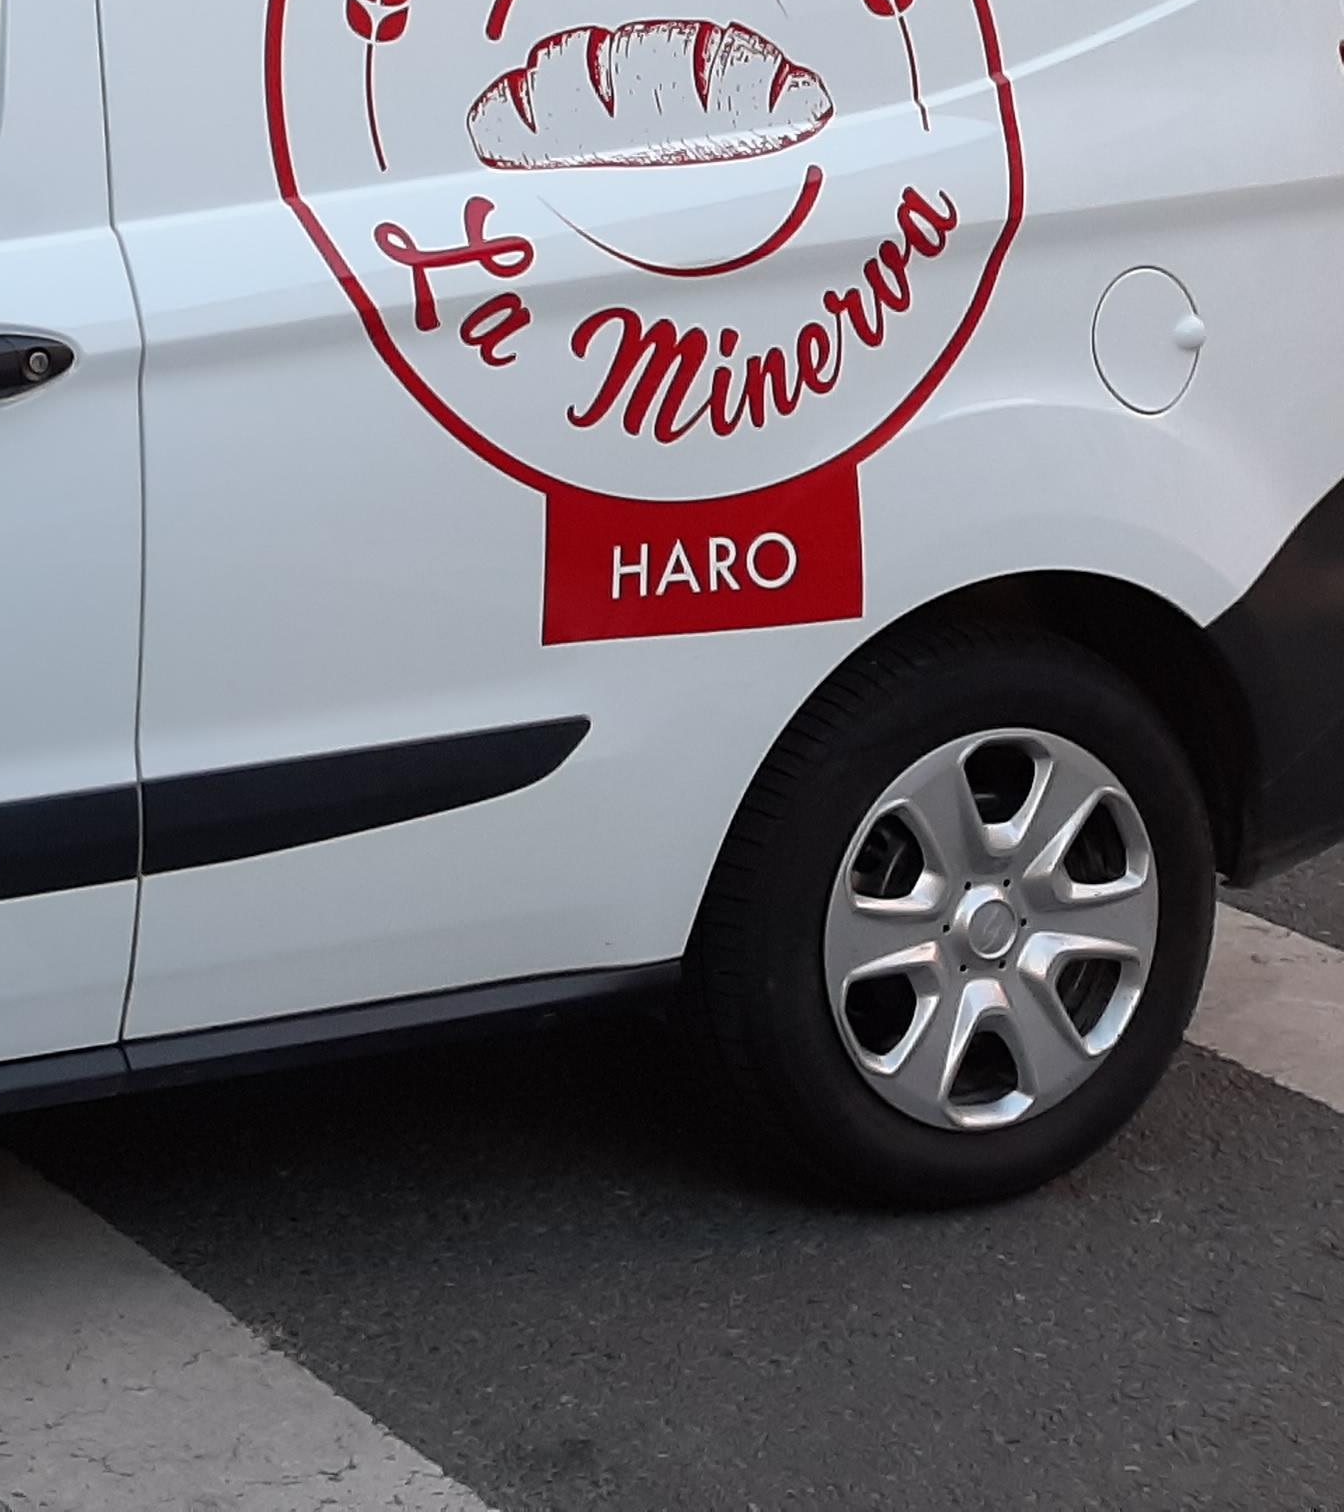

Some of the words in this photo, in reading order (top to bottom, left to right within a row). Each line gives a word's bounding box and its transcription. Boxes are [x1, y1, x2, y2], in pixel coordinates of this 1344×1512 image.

[374, 197, 534, 366] La
[567, 186, 957, 444] Minerva
[611, 532, 798, 599] HARO
